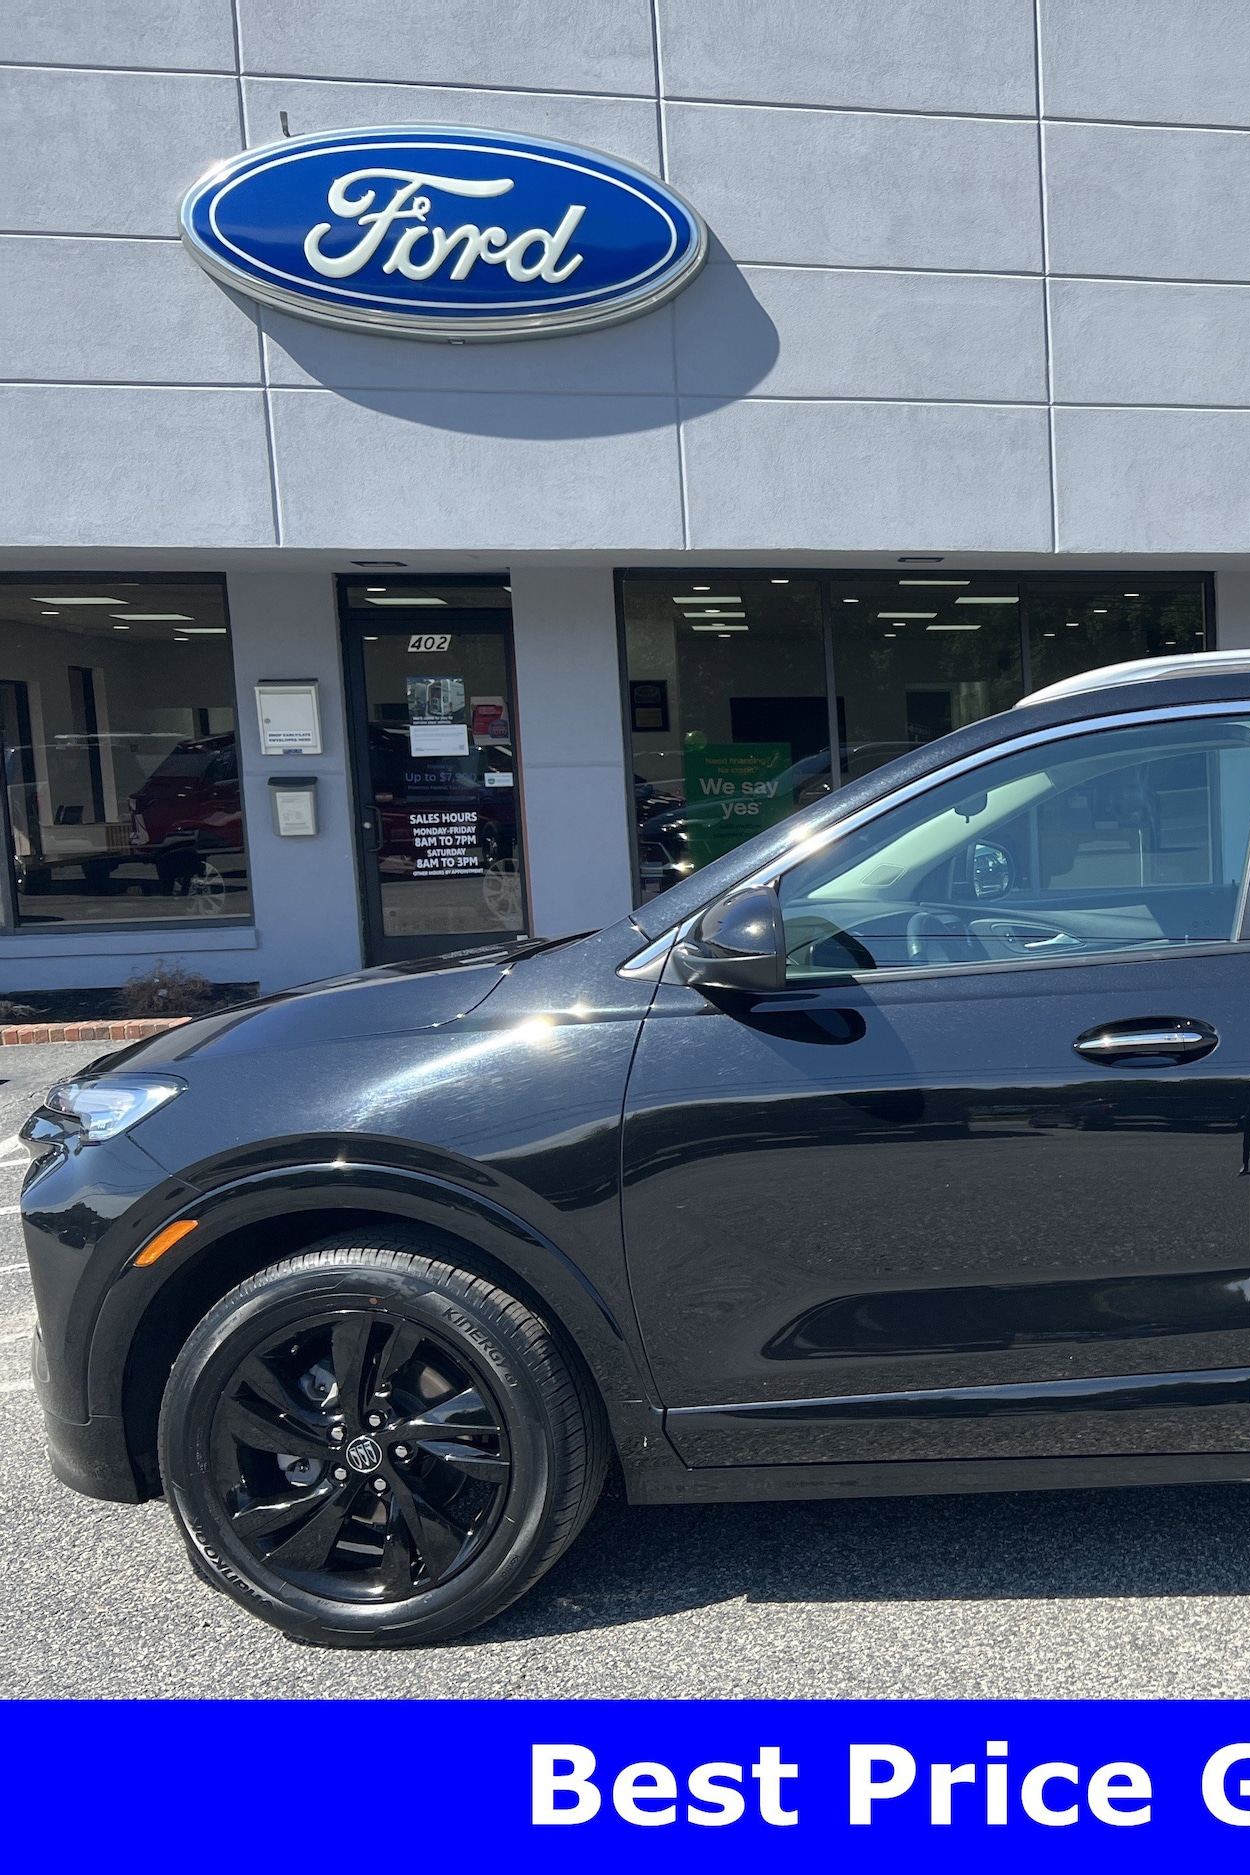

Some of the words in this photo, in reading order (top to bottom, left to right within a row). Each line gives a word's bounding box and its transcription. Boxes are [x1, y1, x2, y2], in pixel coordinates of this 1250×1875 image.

[304, 167, 587, 284] Ford
[410, 636, 448, 650] 402
[405, 772, 422, 783] Up
[424, 772, 437, 782] to
[700, 778, 735, 795] We
[741, 780, 779, 798] say
[409, 813, 440, 825] SALES
[442, 811, 478, 824] HOURS
[721, 802, 760, 820] yes
[413, 825, 477, 837] MONDAY-FRIDAY
[414, 836, 437, 848] 8AM
[439, 835, 453, 846] TO
[455, 834, 477, 845] 7PM
[427, 847, 467, 858] SATURDAY
[416, 858, 439, 869] 8AM
[441, 857, 455, 868] TO
[457, 856, 479, 867] 3PM
